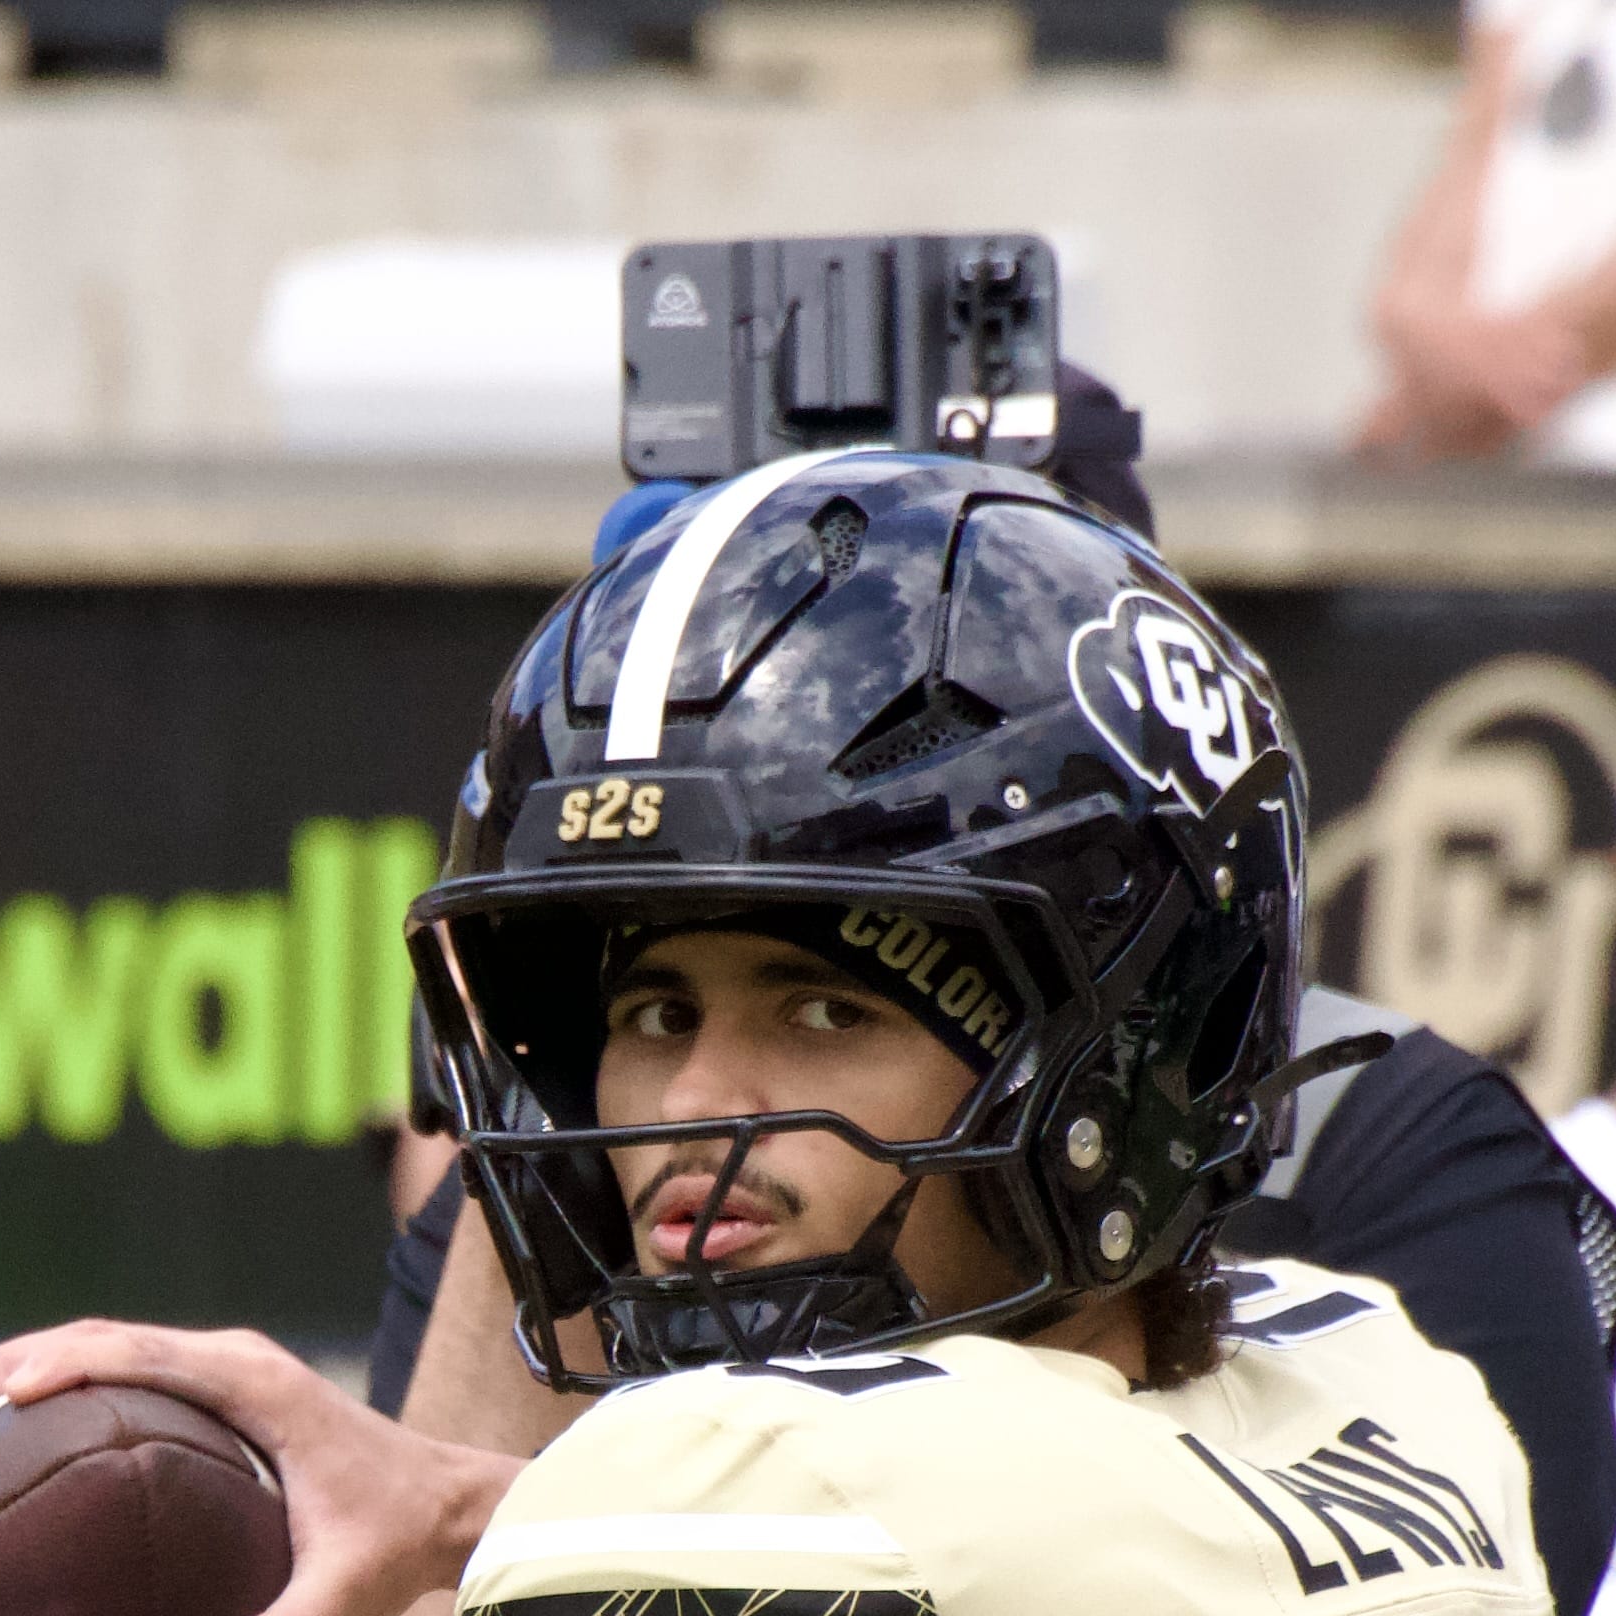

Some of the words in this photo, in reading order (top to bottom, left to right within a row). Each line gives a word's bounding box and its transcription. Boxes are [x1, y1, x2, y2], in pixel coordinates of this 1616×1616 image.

[1134, 613, 1255, 793] CU
[839, 901, 1011, 1058] COLOR
[1175, 1416, 1505, 1597] LEWIS
